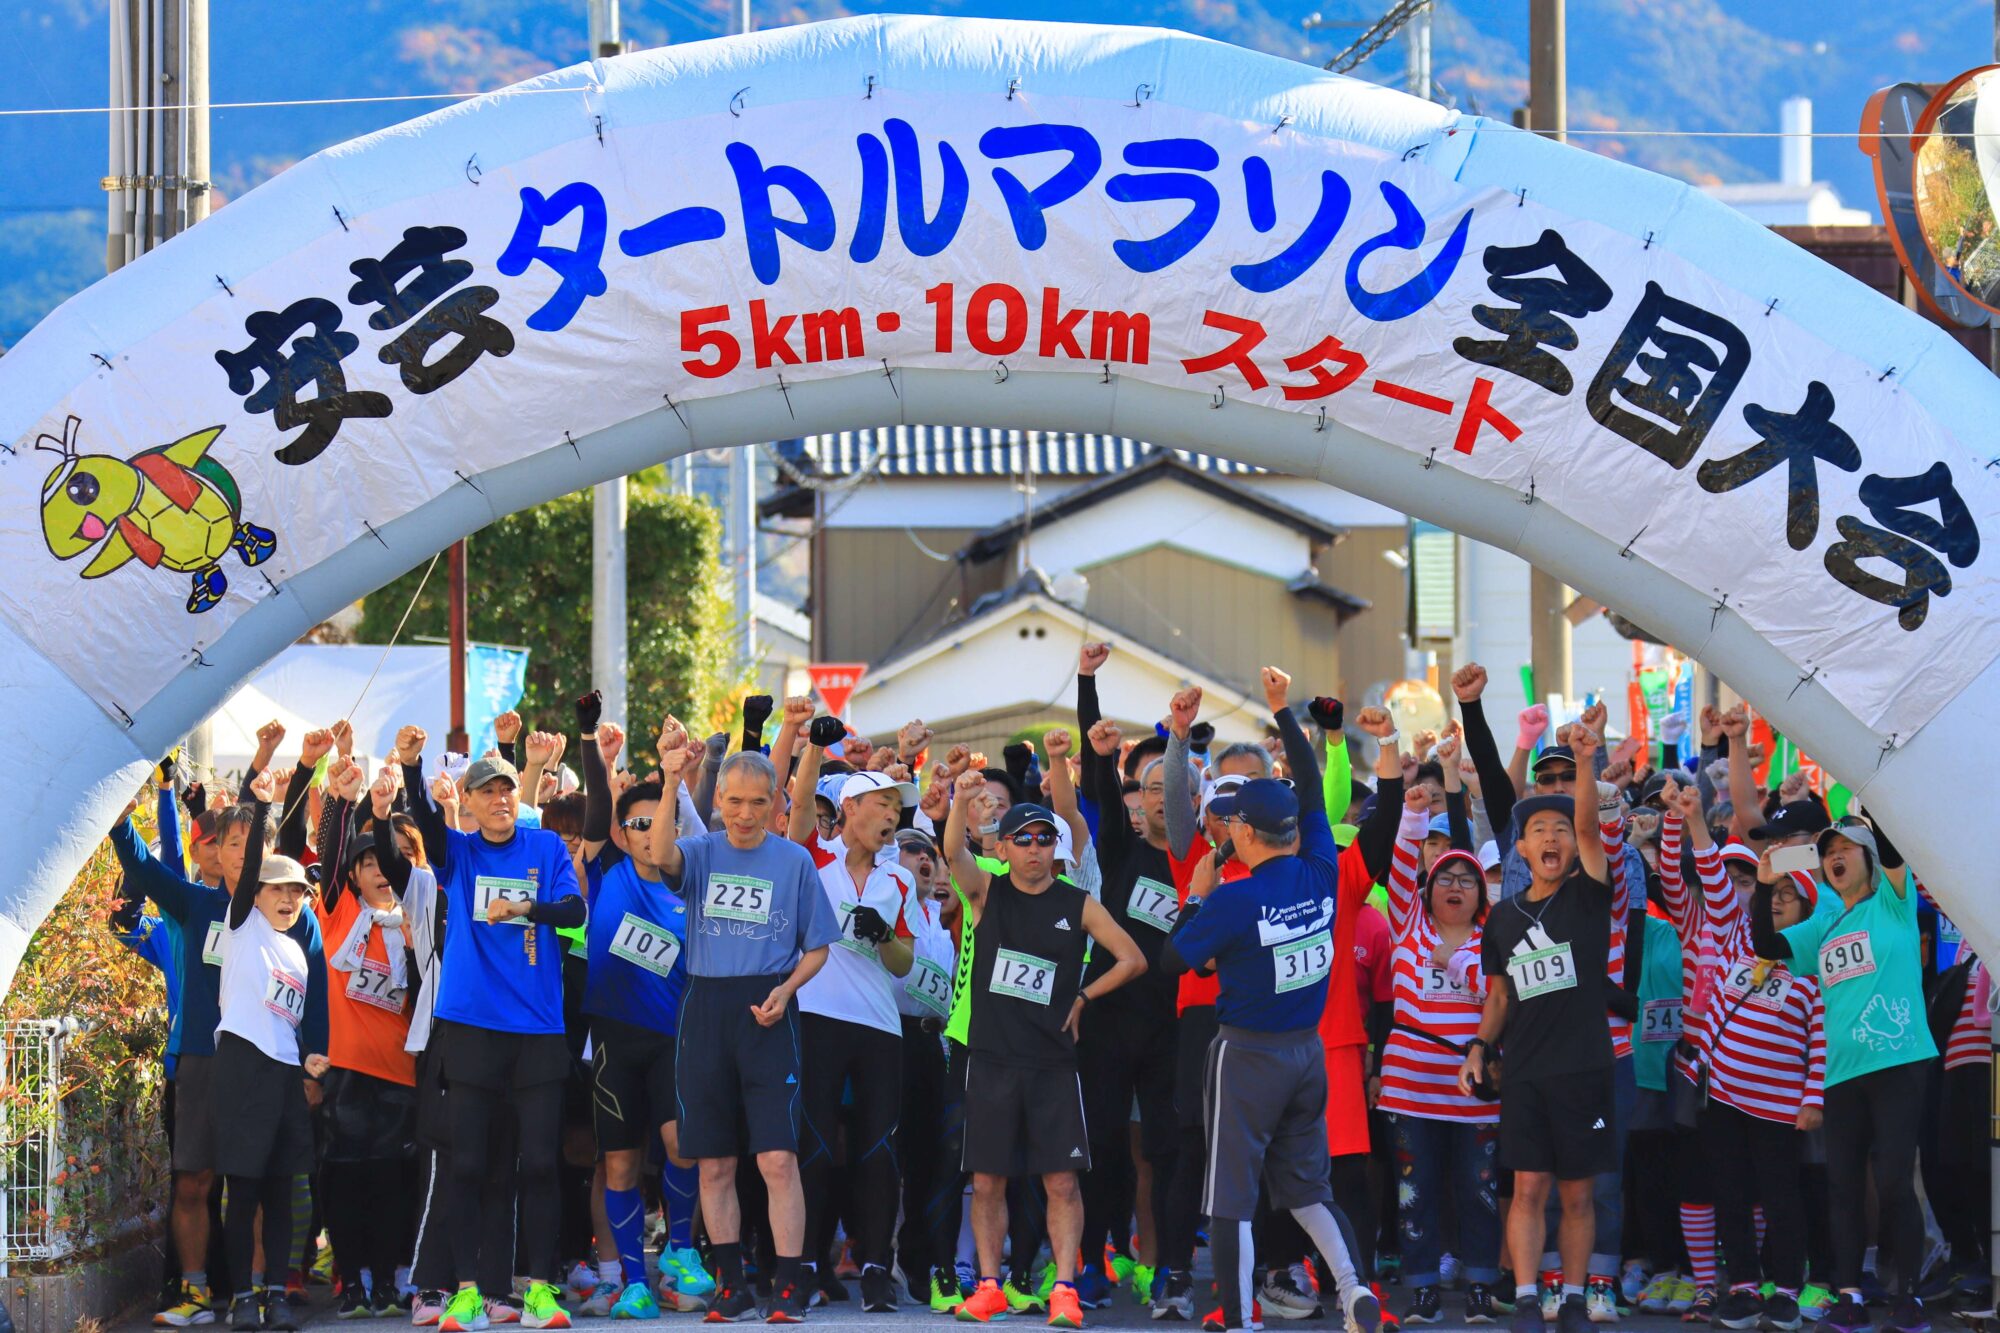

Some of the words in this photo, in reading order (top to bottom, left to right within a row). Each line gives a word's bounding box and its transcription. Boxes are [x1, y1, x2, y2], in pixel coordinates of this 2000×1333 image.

[1181, 309, 1523, 455] スタート
[713, 883, 764, 910] 225
[1136, 887, 1180, 923] 172
[623, 926, 672, 961] 107
[1825, 941, 1865, 974] 690
[1002, 960, 1046, 990] 128
[1285, 944, 1327, 978] 313
[1520, 954, 1565, 987] 109
[273, 979, 305, 1014] 707
[917, 967, 949, 1002] 153
[1735, 967, 1782, 998] 68
